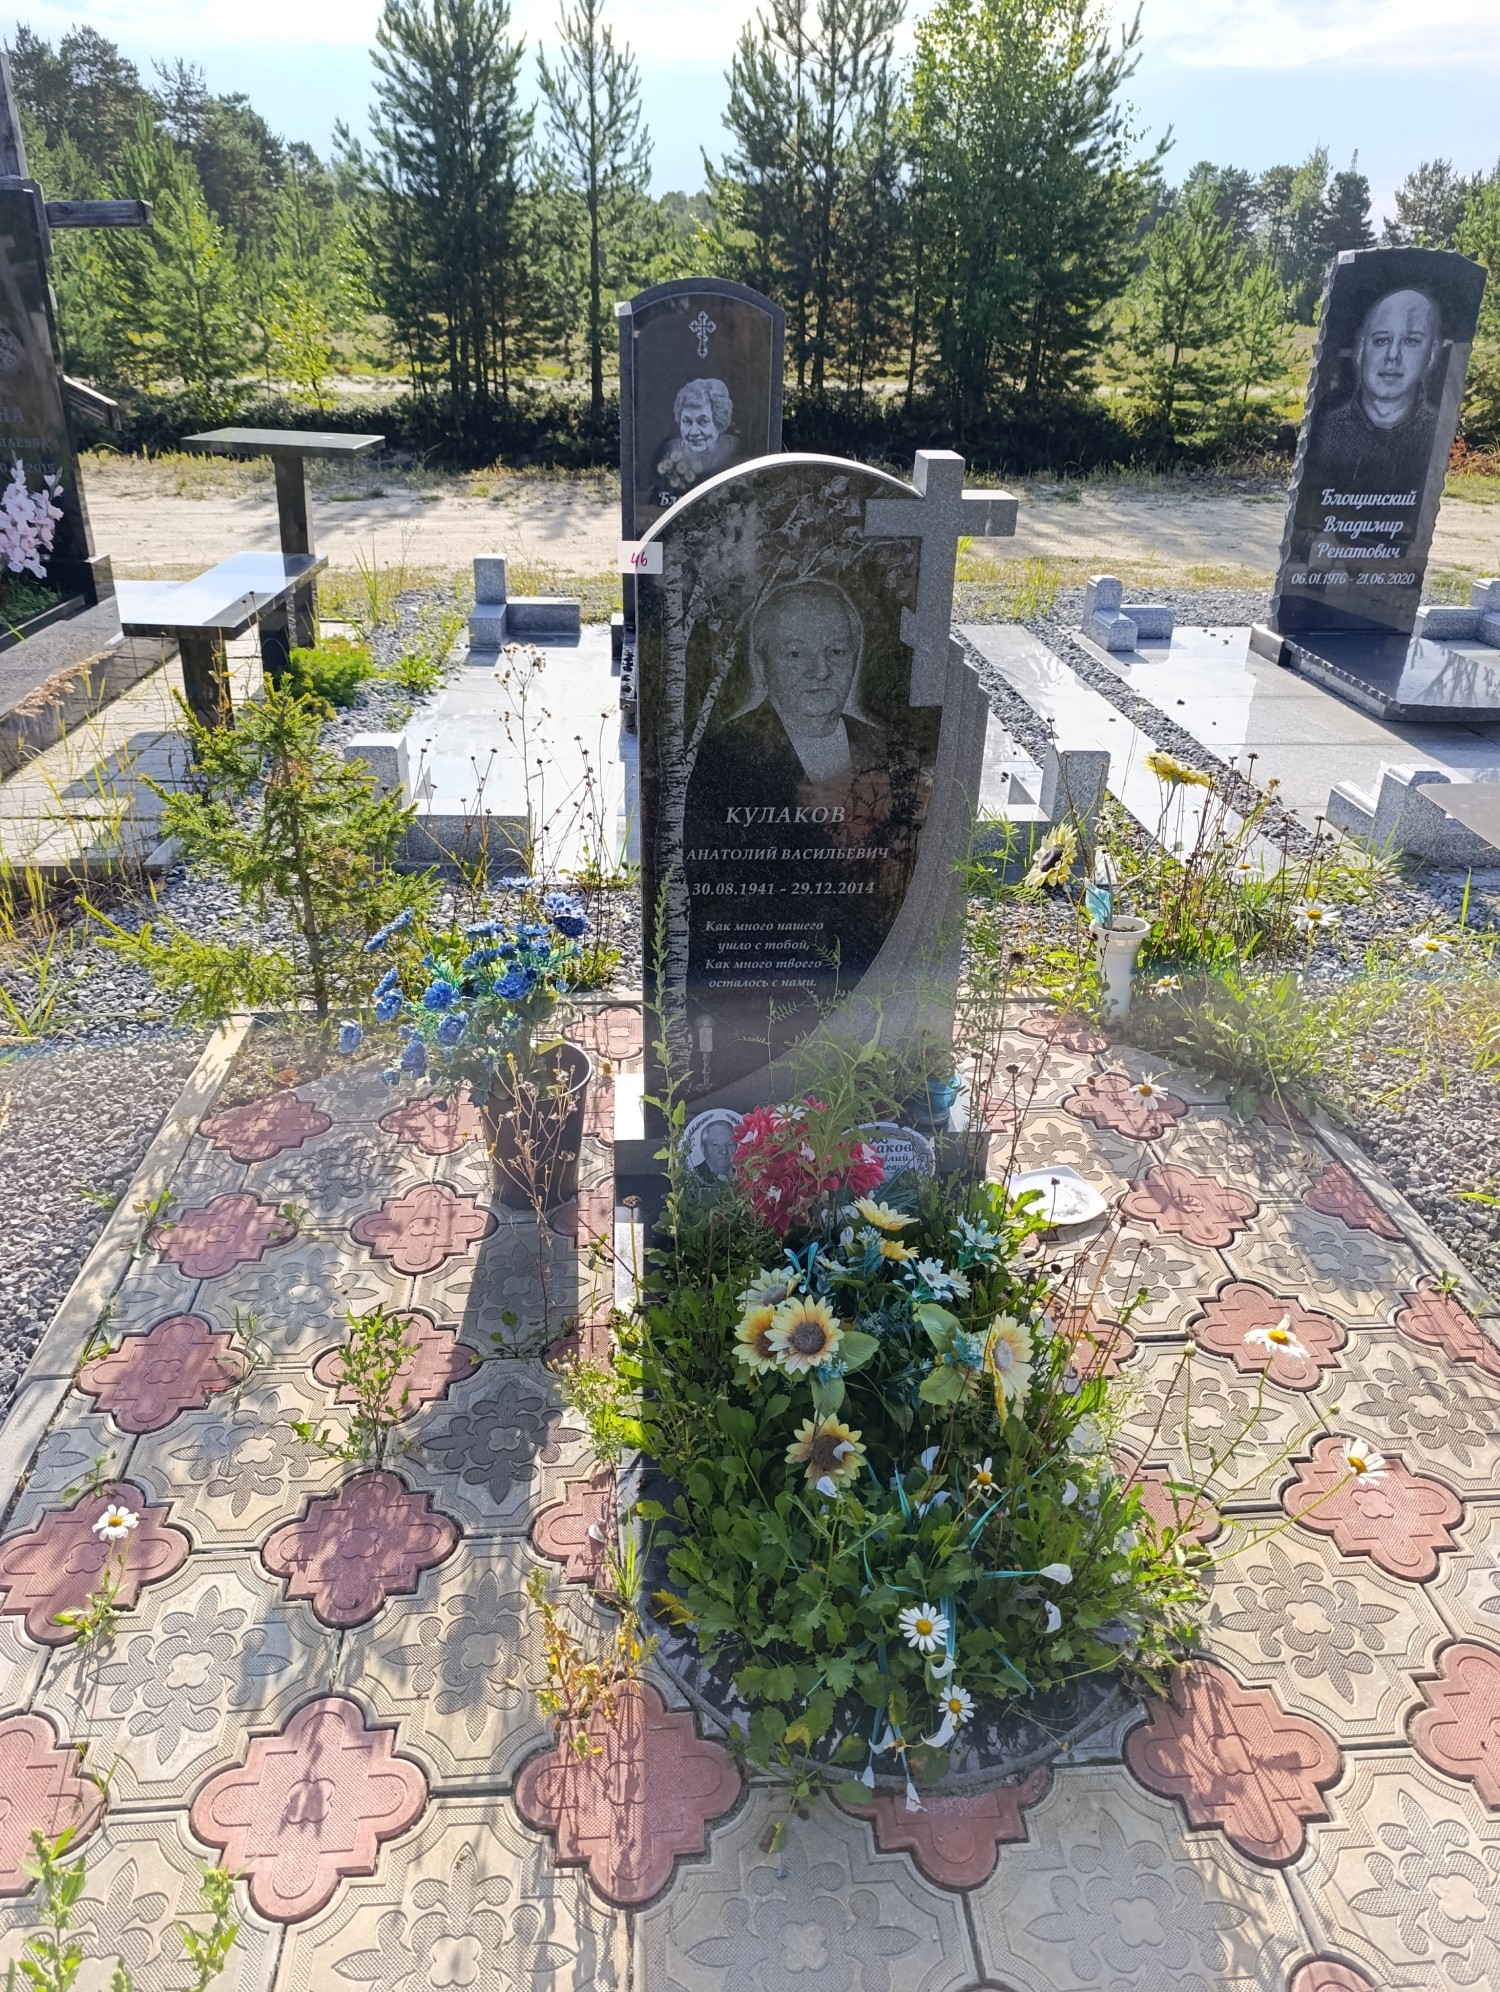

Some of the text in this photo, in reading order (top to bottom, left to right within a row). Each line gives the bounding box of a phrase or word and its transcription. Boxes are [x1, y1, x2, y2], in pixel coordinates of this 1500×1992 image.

[1320, 488, 1417, 509] Блощинский
[1322, 515, 1403, 540] Владимир
[1317, 542, 1401, 558] Ренатович
[630, 550, 648, 568] 46
[1291, 573, 1347, 585] 06.01.1976
[1356, 573, 1416, 585] 21.06.2020
[725, 806, 846, 827] КУЛАКОВ
[686, 847, 889, 861] АНАТОЛИЙ ВАСИЛЬЕВИЧ
[692, 882, 775, 896] 30.08.1941
[790, 881, 875, 895] 29.12.2014
[705, 920, 824, 931] Как много нашего
[717, 939, 810, 953] ушло с тобой,
[705, 958, 822, 969] Как много твоего
[708, 978, 817, 988] осталось с нами.
